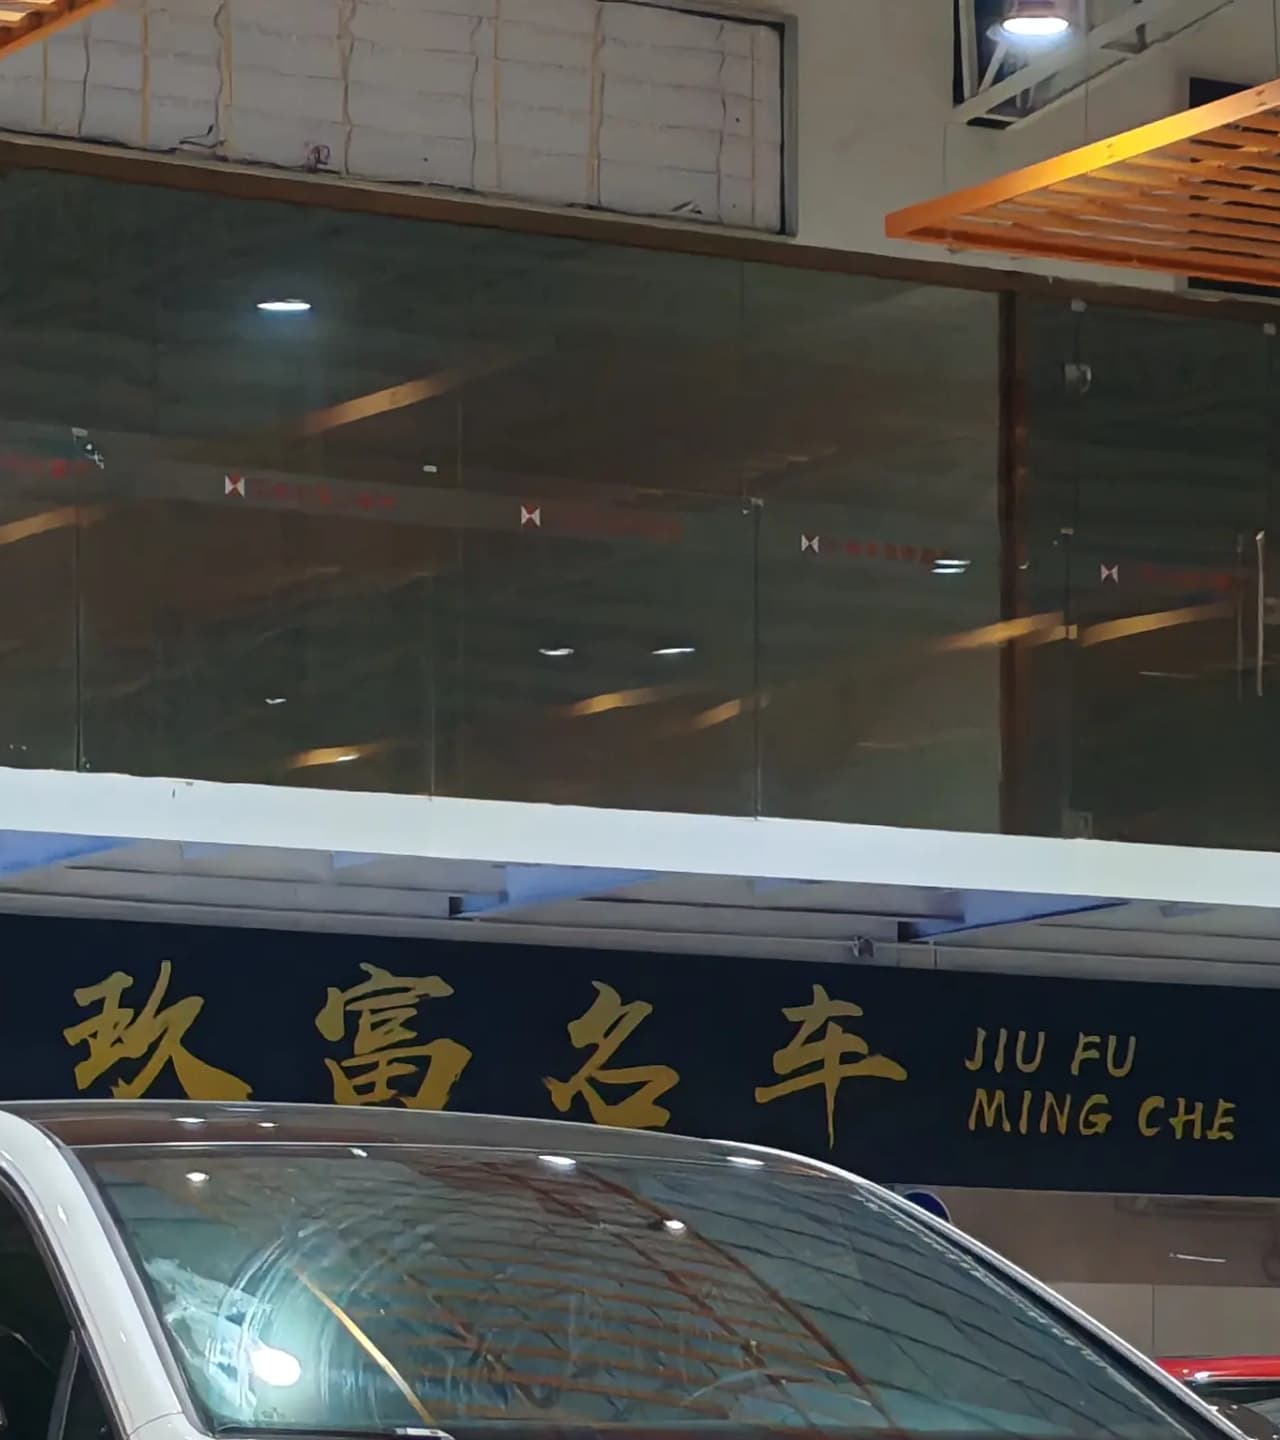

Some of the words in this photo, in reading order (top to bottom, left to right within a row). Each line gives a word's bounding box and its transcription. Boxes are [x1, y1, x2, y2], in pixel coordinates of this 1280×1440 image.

[62, 960, 908, 1149] 玖富名车
[964, 1027, 1046, 1073] JIU
[1071, 1032, 1137, 1078] FU
[968, 1088, 1113, 1136] MING
[1138, 1096, 1237, 1141] CHE
